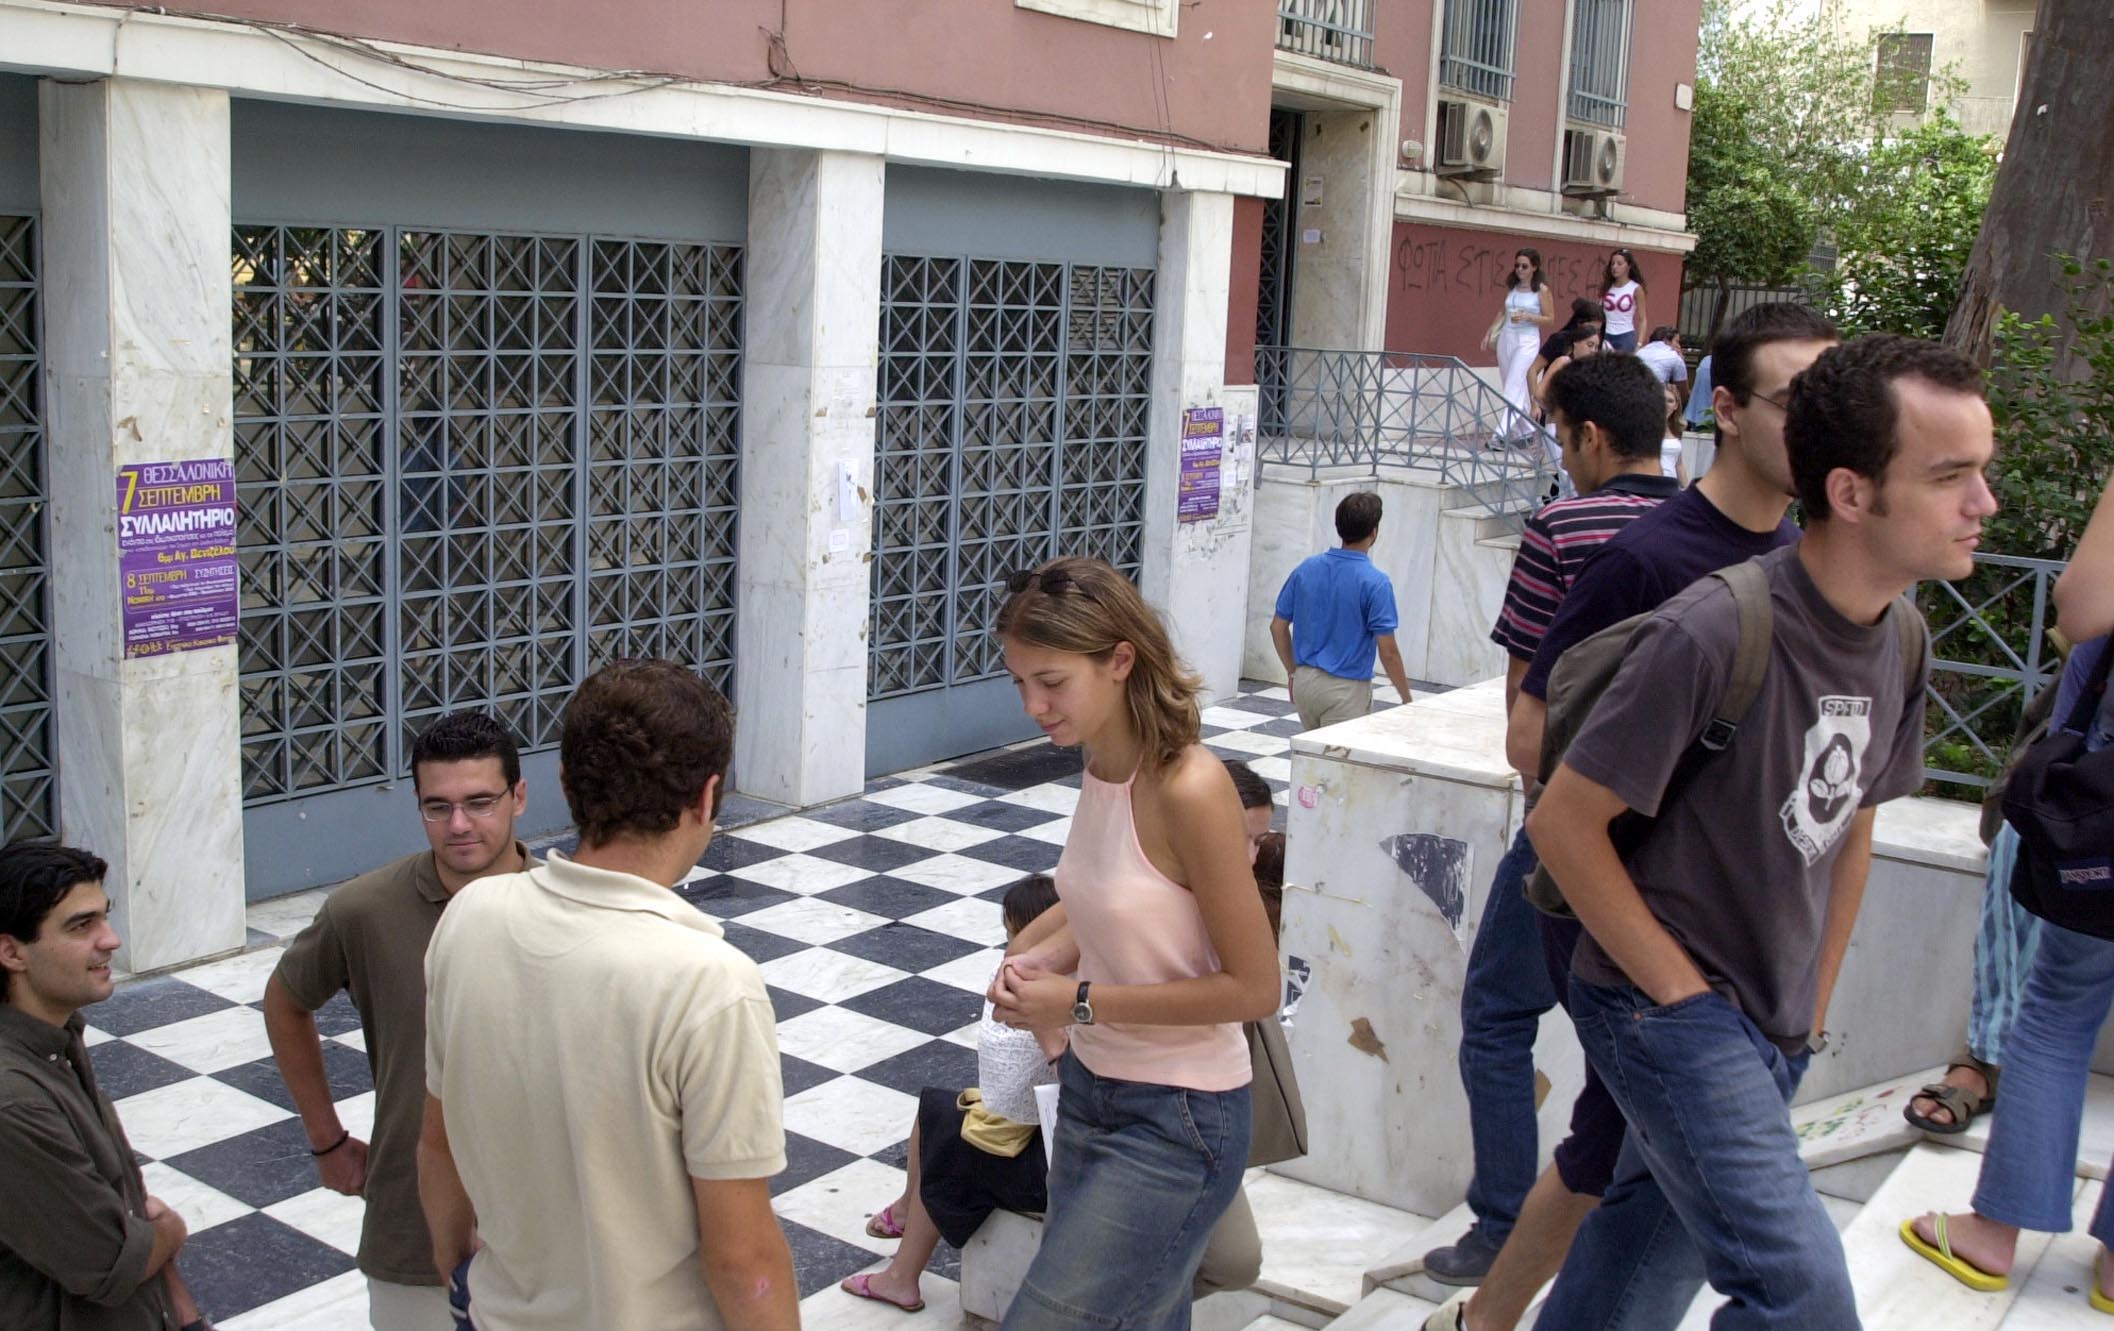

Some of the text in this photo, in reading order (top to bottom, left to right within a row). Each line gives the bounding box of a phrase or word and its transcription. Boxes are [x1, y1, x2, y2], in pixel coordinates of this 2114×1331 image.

[143, 462, 232, 483] ΘΕΣΣΑΛΟΝΙΚΗ
[119, 471, 138, 514] 7
[139, 484, 220, 508] ΣΕΠΤΕΜΒΡΗ
[120, 508, 234, 537] ΣΥΛΛΑΛΗΤΗΡΙΟ
[127, 572, 136, 588] 8
